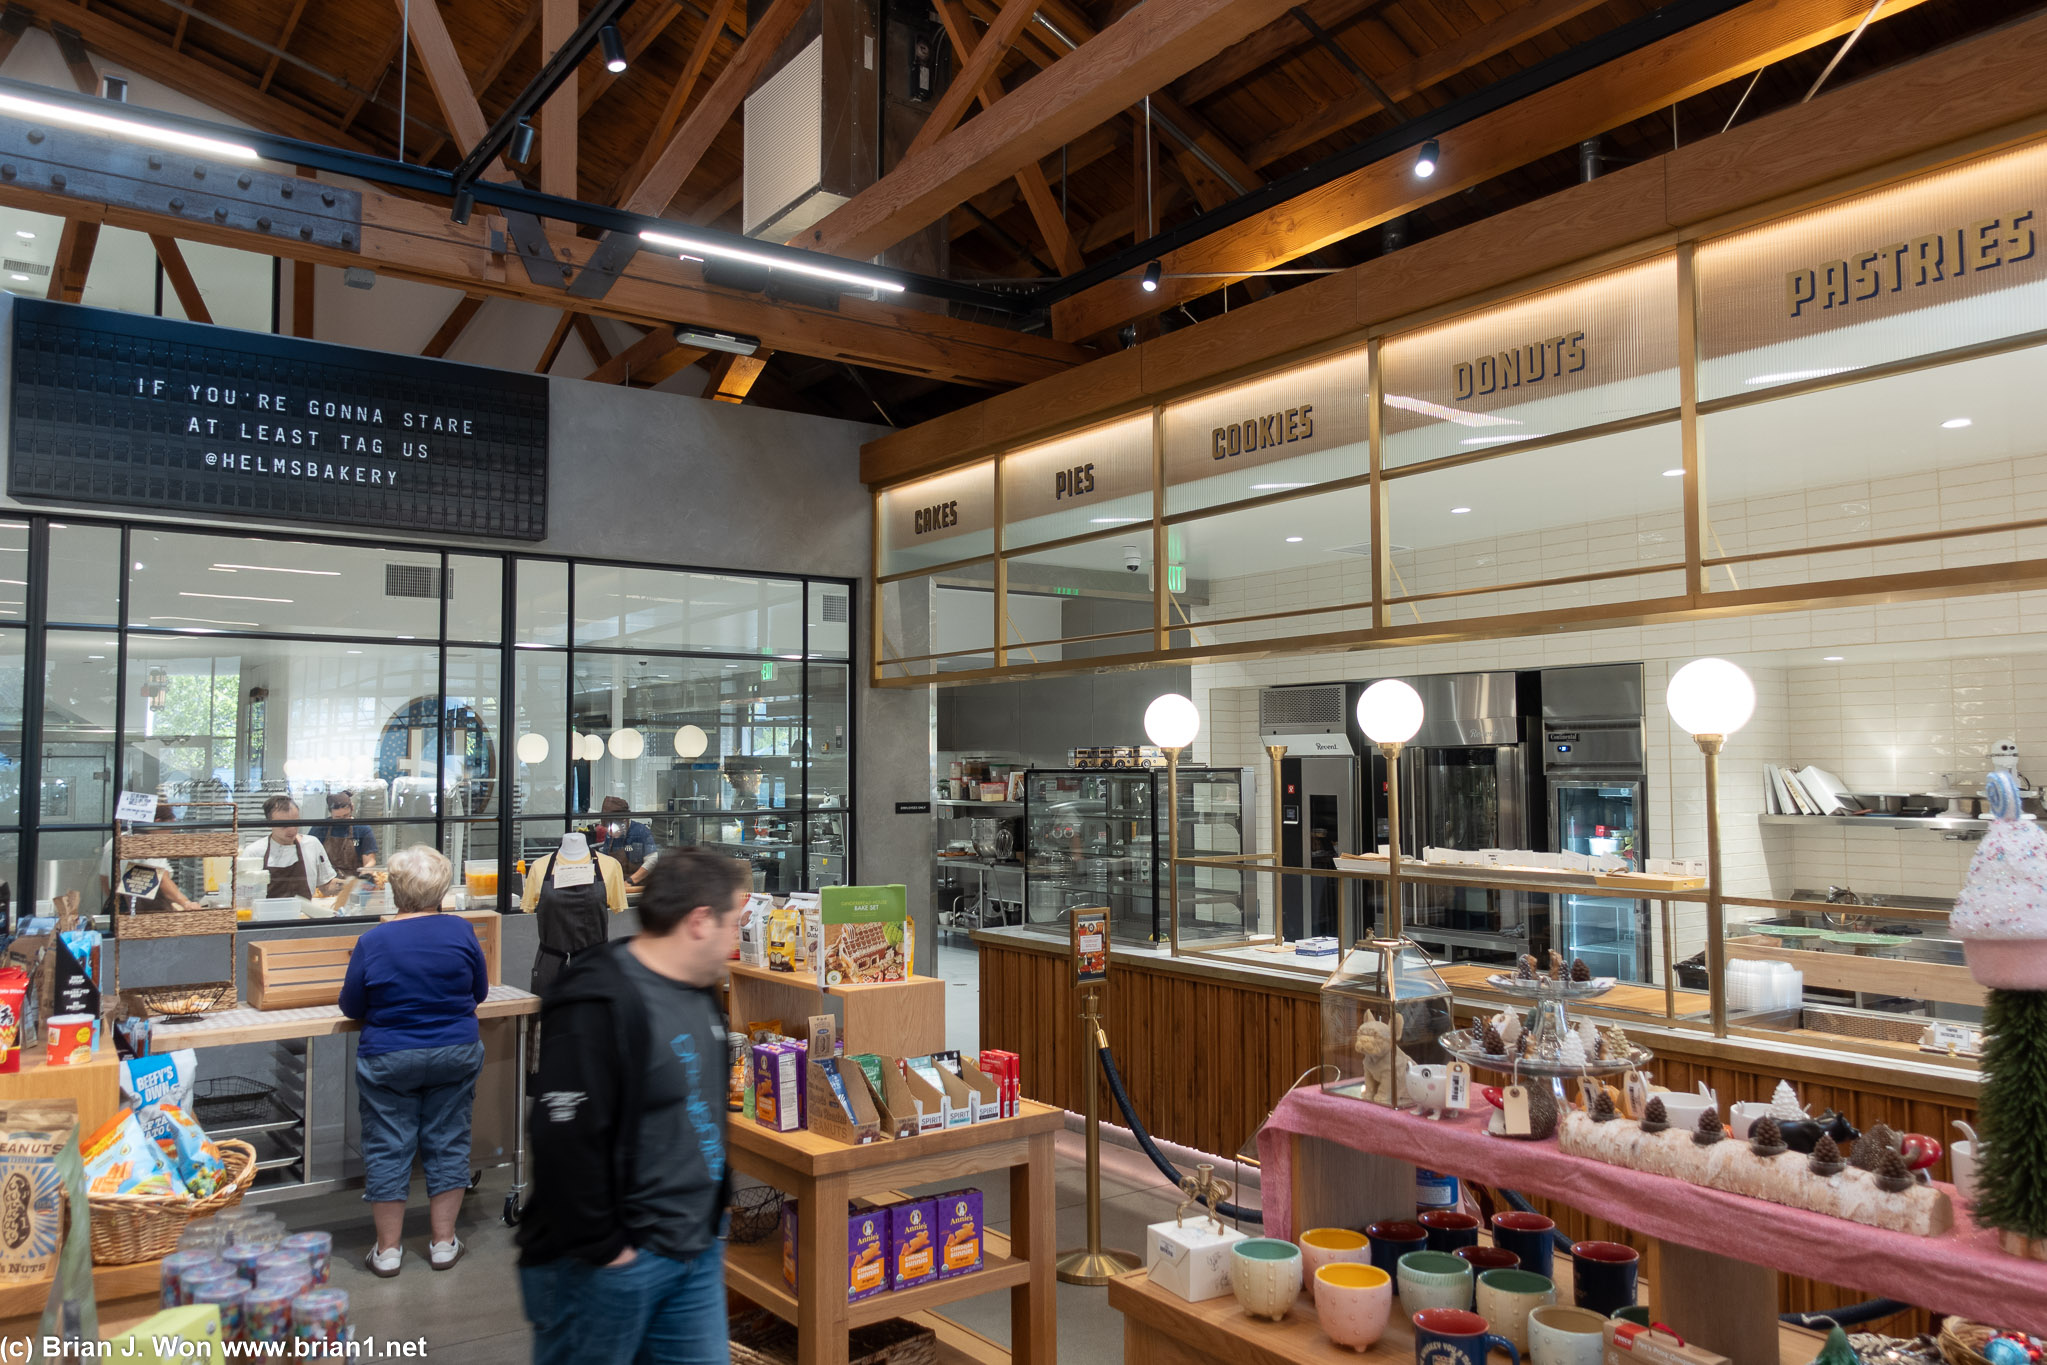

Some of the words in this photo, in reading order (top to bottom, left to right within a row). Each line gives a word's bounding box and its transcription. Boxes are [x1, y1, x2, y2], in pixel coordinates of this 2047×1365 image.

[1785, 210, 2035, 317] PASTRIES
[1452, 331, 1586, 401] DONUTS
[138, 378, 164, 396] IF
[190, 384, 287, 412] YOU'RE
[308, 400, 384, 424] GONNA
[403, 413, 473, 436] STARE
[188, 417, 217, 435] AT
[241, 424, 319, 447] LEAST
[341, 435, 383, 455] TAG
[403, 442, 429, 459] US
[1211, 404, 1314, 460] COOKIES
[205, 452, 398, 486] @HELMSBAKERY
[1055, 463, 1094, 500] PIES
[915, 500, 958, 535] CAKES
[1315, 741, 1338, 751] Revent
[136, 1065, 174, 1092] BEEFY'S
[145, 1082, 170, 1102] OWN
[950, 1111, 969, 1120] SPIRIT
[980, 1106, 998, 1114] SPIRIT
[921, 1115, 942, 1125] SPIRIT
[950, 1214, 973, 1225] Annie's
[904, 1222, 927, 1234] Annie's
[857, 1233, 879, 1246] Annie's
[950, 1243, 973, 1253] CHEDDAR
[950, 1247, 973, 1258] BUNNIES
[904, 1252, 928, 1262] CHEDDAR
[905, 1256, 928, 1268] BUNNIES
[857, 1263, 879, 1273] CHEDDAR
[857, 1268, 879, 1280] BUNNIES
